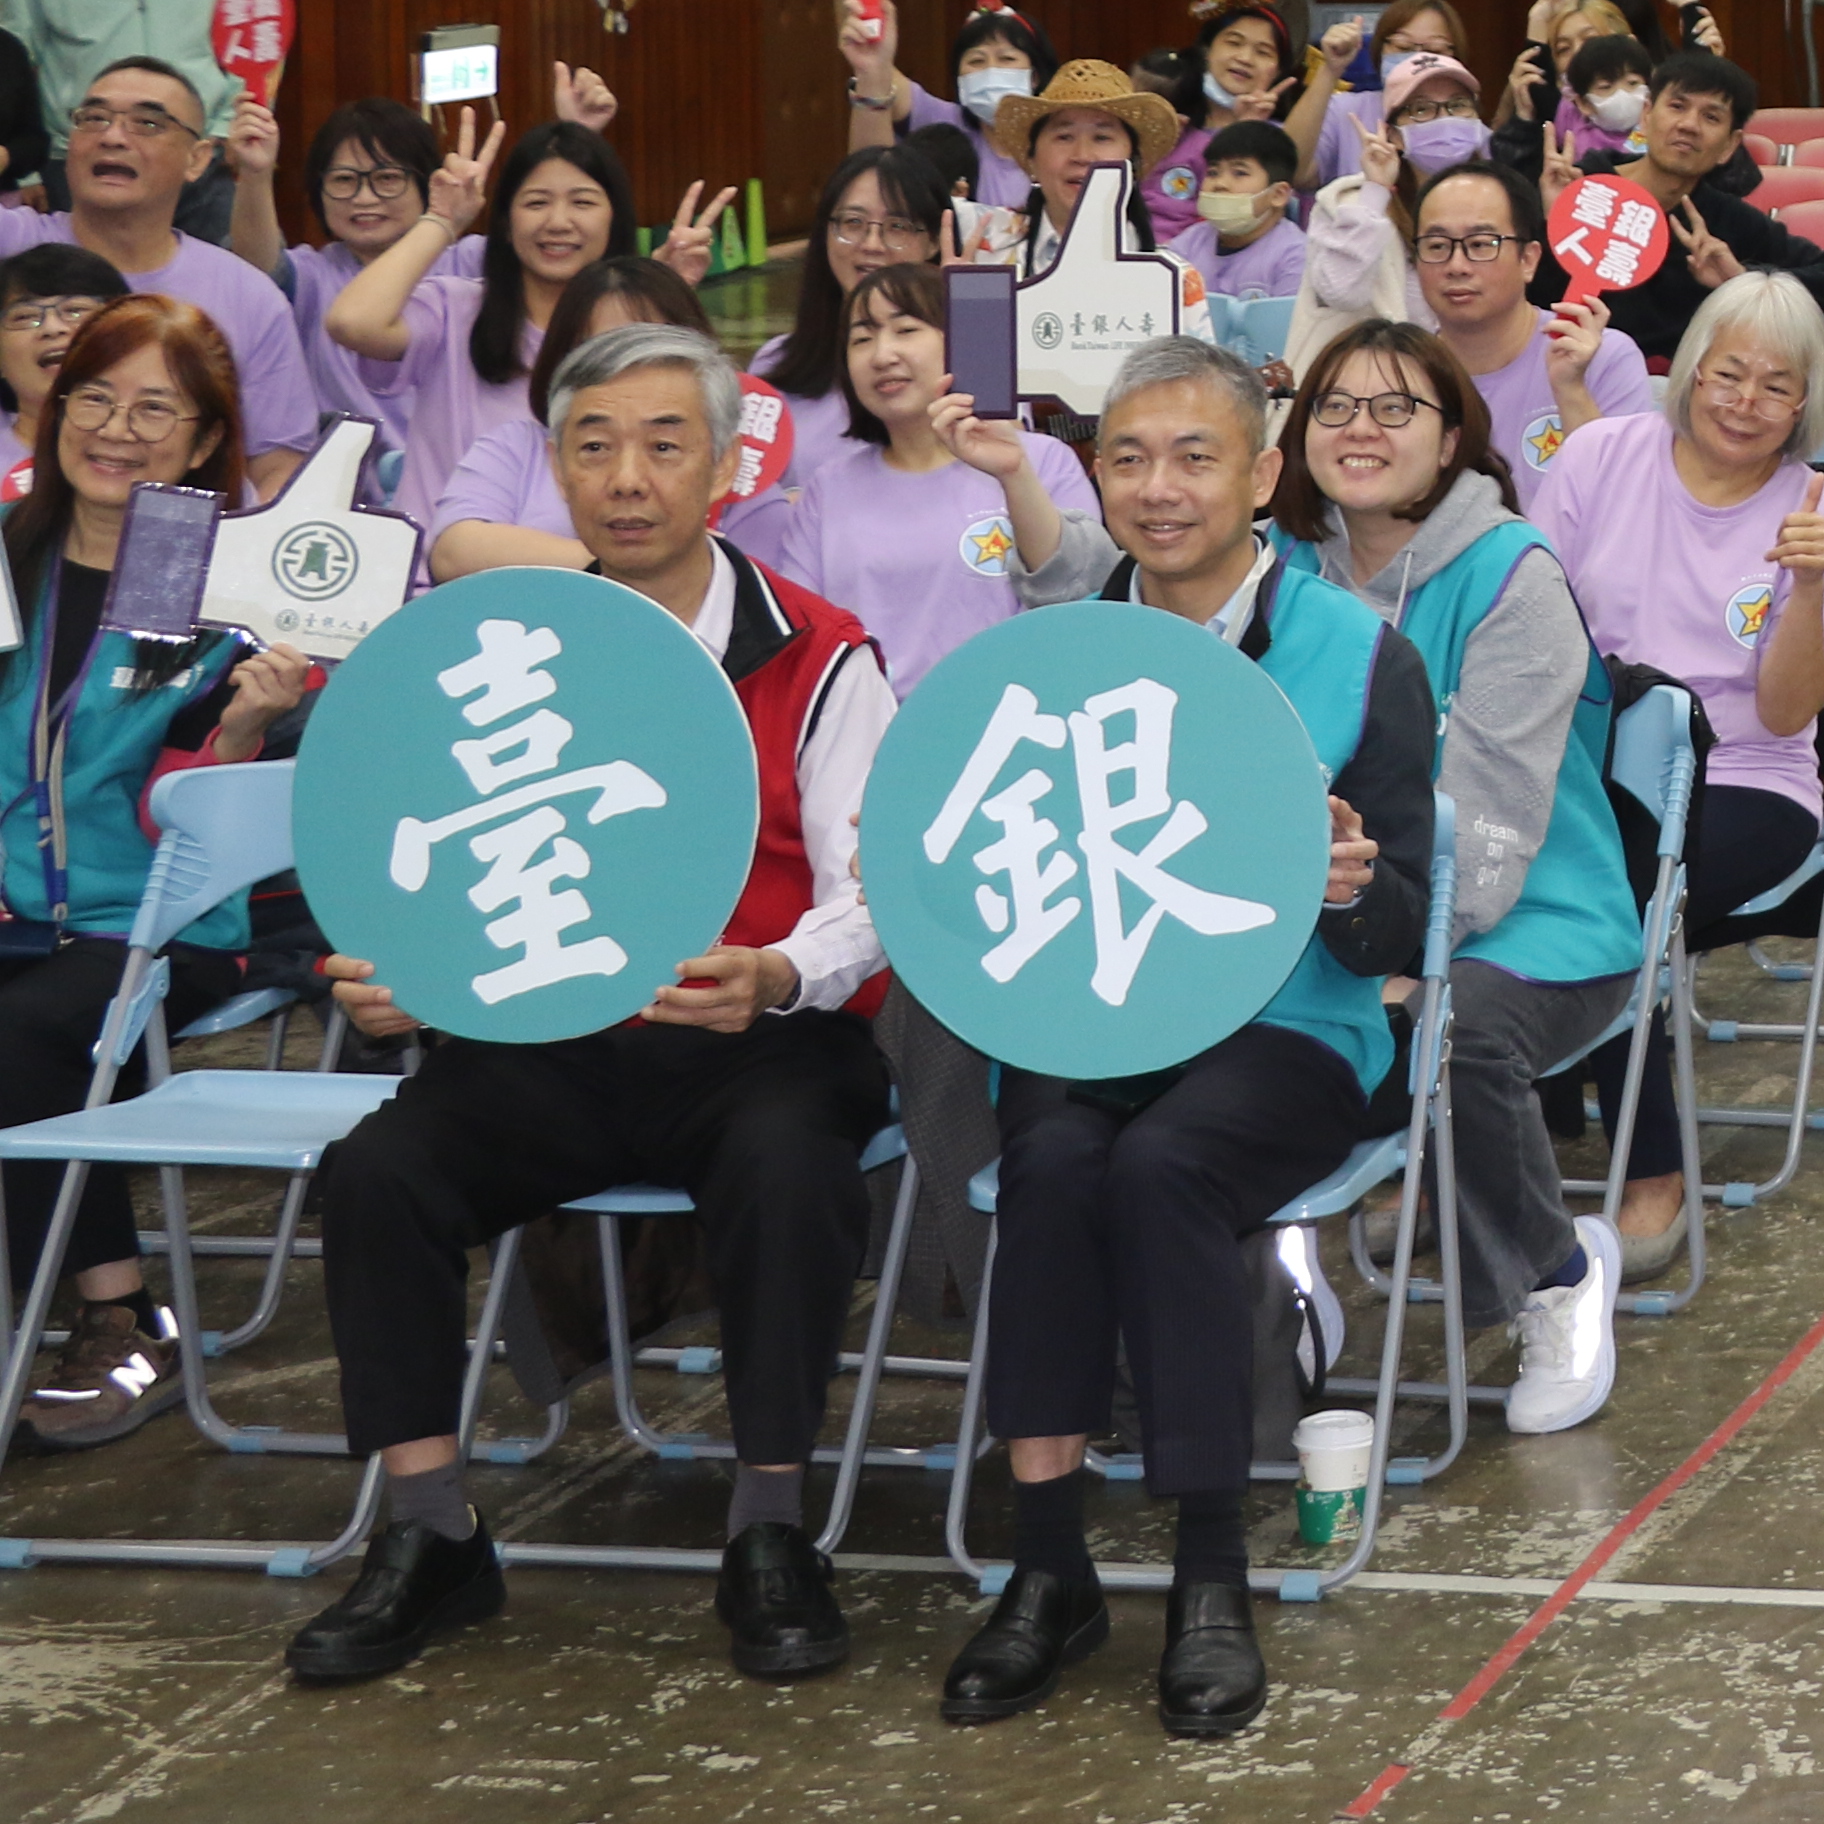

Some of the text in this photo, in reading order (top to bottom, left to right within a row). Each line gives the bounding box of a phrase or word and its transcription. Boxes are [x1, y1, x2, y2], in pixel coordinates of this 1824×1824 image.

[390, 618, 667, 1006] 臺
[923, 677, 1277, 1006] 銀
[1474, 813, 1518, 843] dream
[1487, 841, 1503, 860] on
